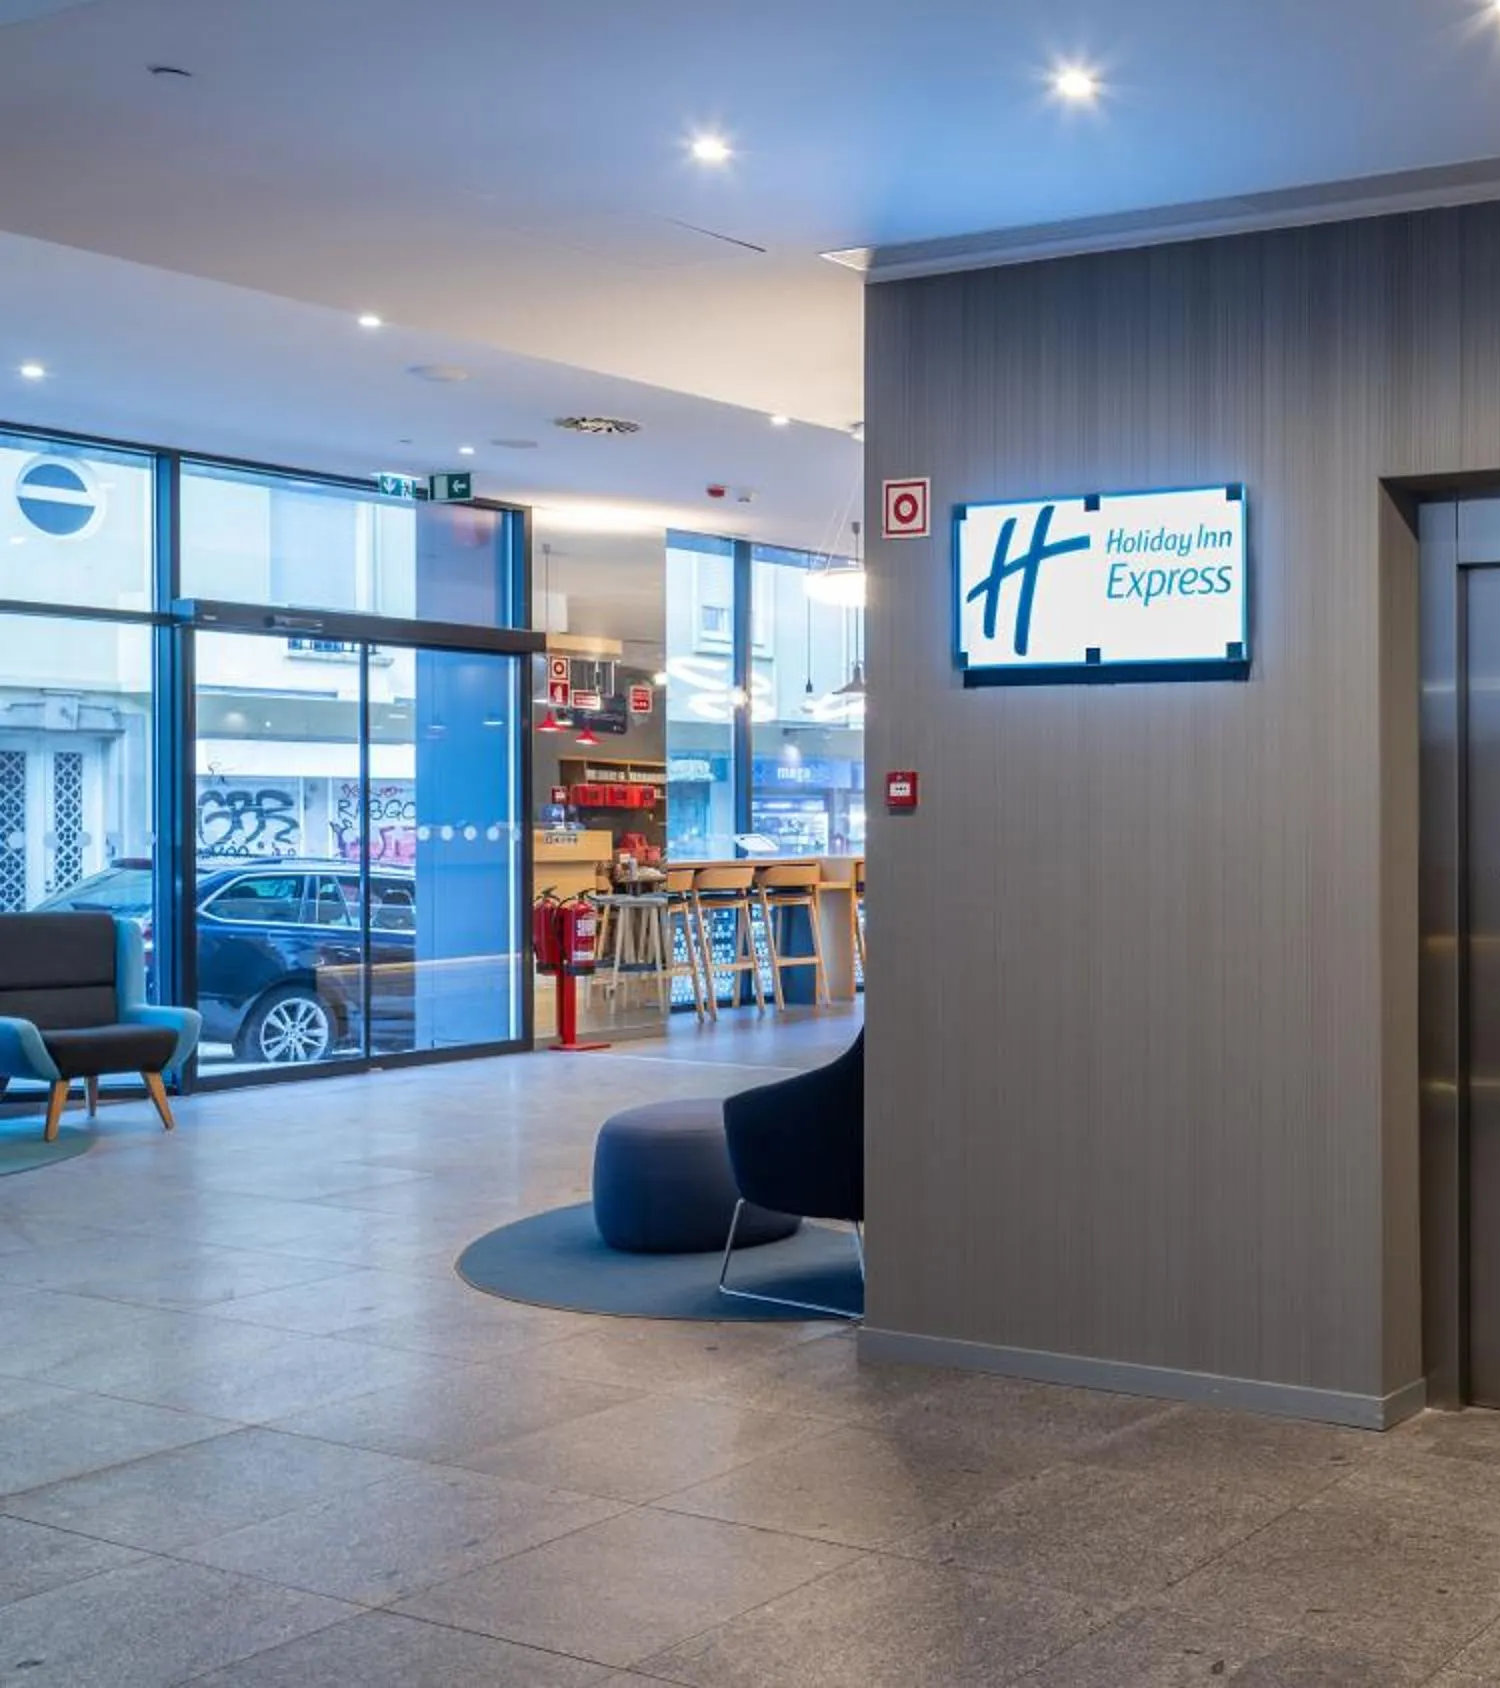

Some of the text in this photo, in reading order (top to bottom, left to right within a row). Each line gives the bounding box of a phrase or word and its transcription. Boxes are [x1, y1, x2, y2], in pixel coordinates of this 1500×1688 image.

[1106, 523, 1232, 557] Holiday Inn
[1106, 563, 1233, 607] Express
